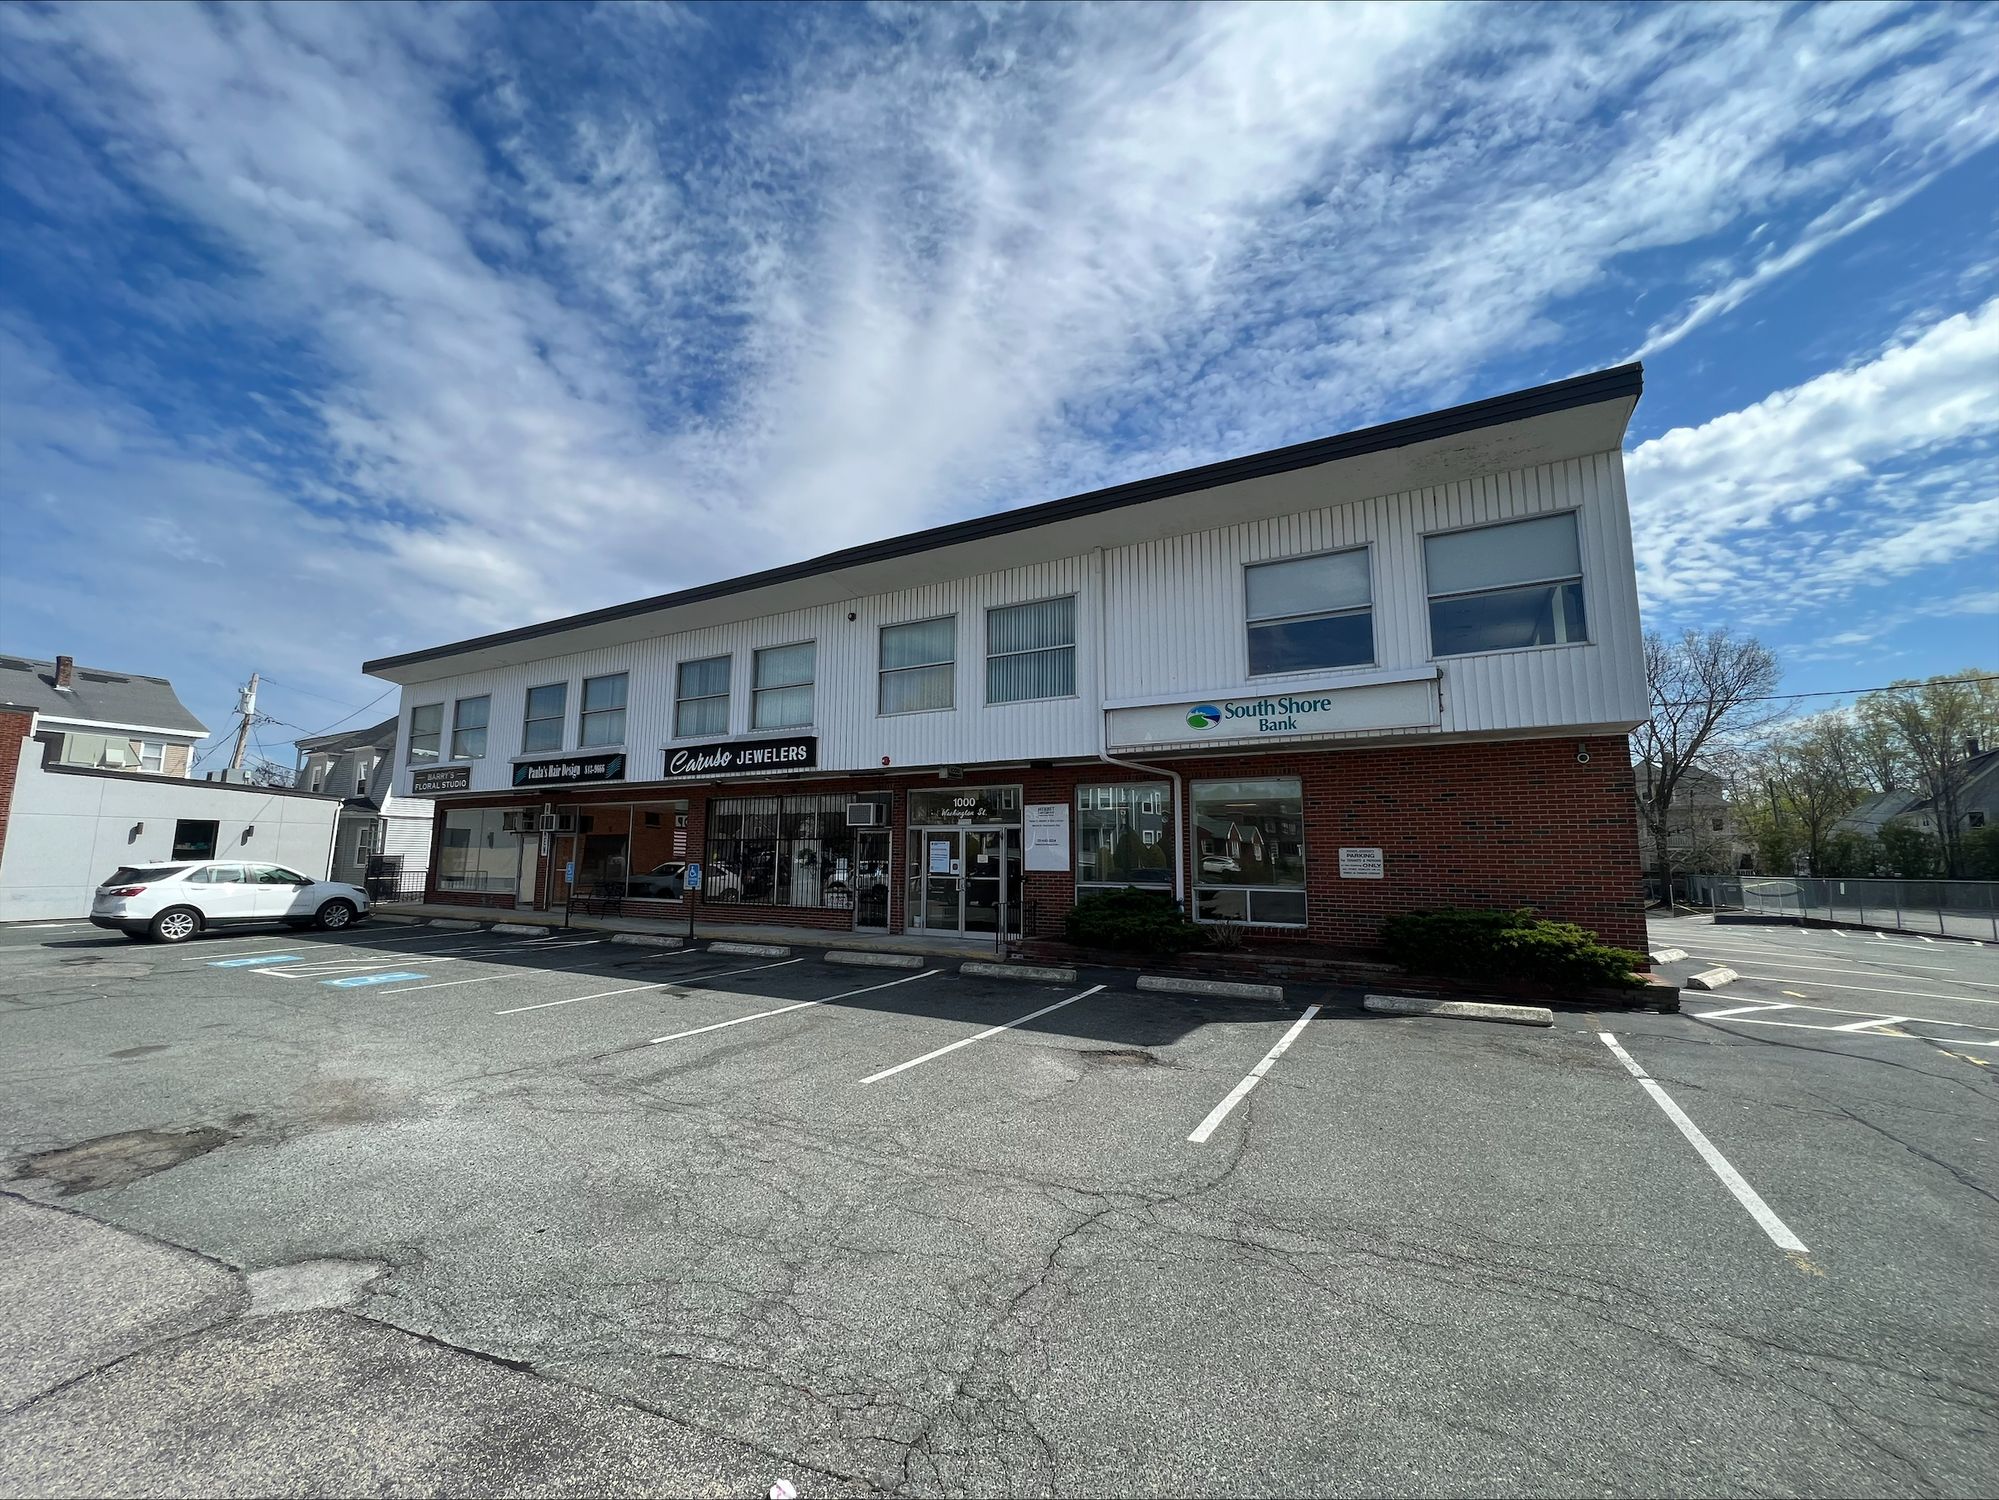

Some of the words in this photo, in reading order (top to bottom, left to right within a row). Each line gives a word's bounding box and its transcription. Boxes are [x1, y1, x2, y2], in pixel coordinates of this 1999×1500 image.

[1224, 699, 1275, 719] South
[1278, 697, 1332, 715] Shore
[1259, 716, 1297, 732] Bank
[670, 747, 732, 774] Caruso
[736, 745, 807, 765] JEWELERS
[427, 771, 455, 781] BARRY'S
[528, 765, 548, 779] Paula's
[548, 763, 562, 777] Hair
[561, 762, 581, 779] Design
[415, 782, 440, 790] FLORAL
[441, 779, 467, 789] STUDIO
[953, 797, 976, 807] 1000
[941, 808, 975, 818] Washington
[977, 807, 988, 816] St.
